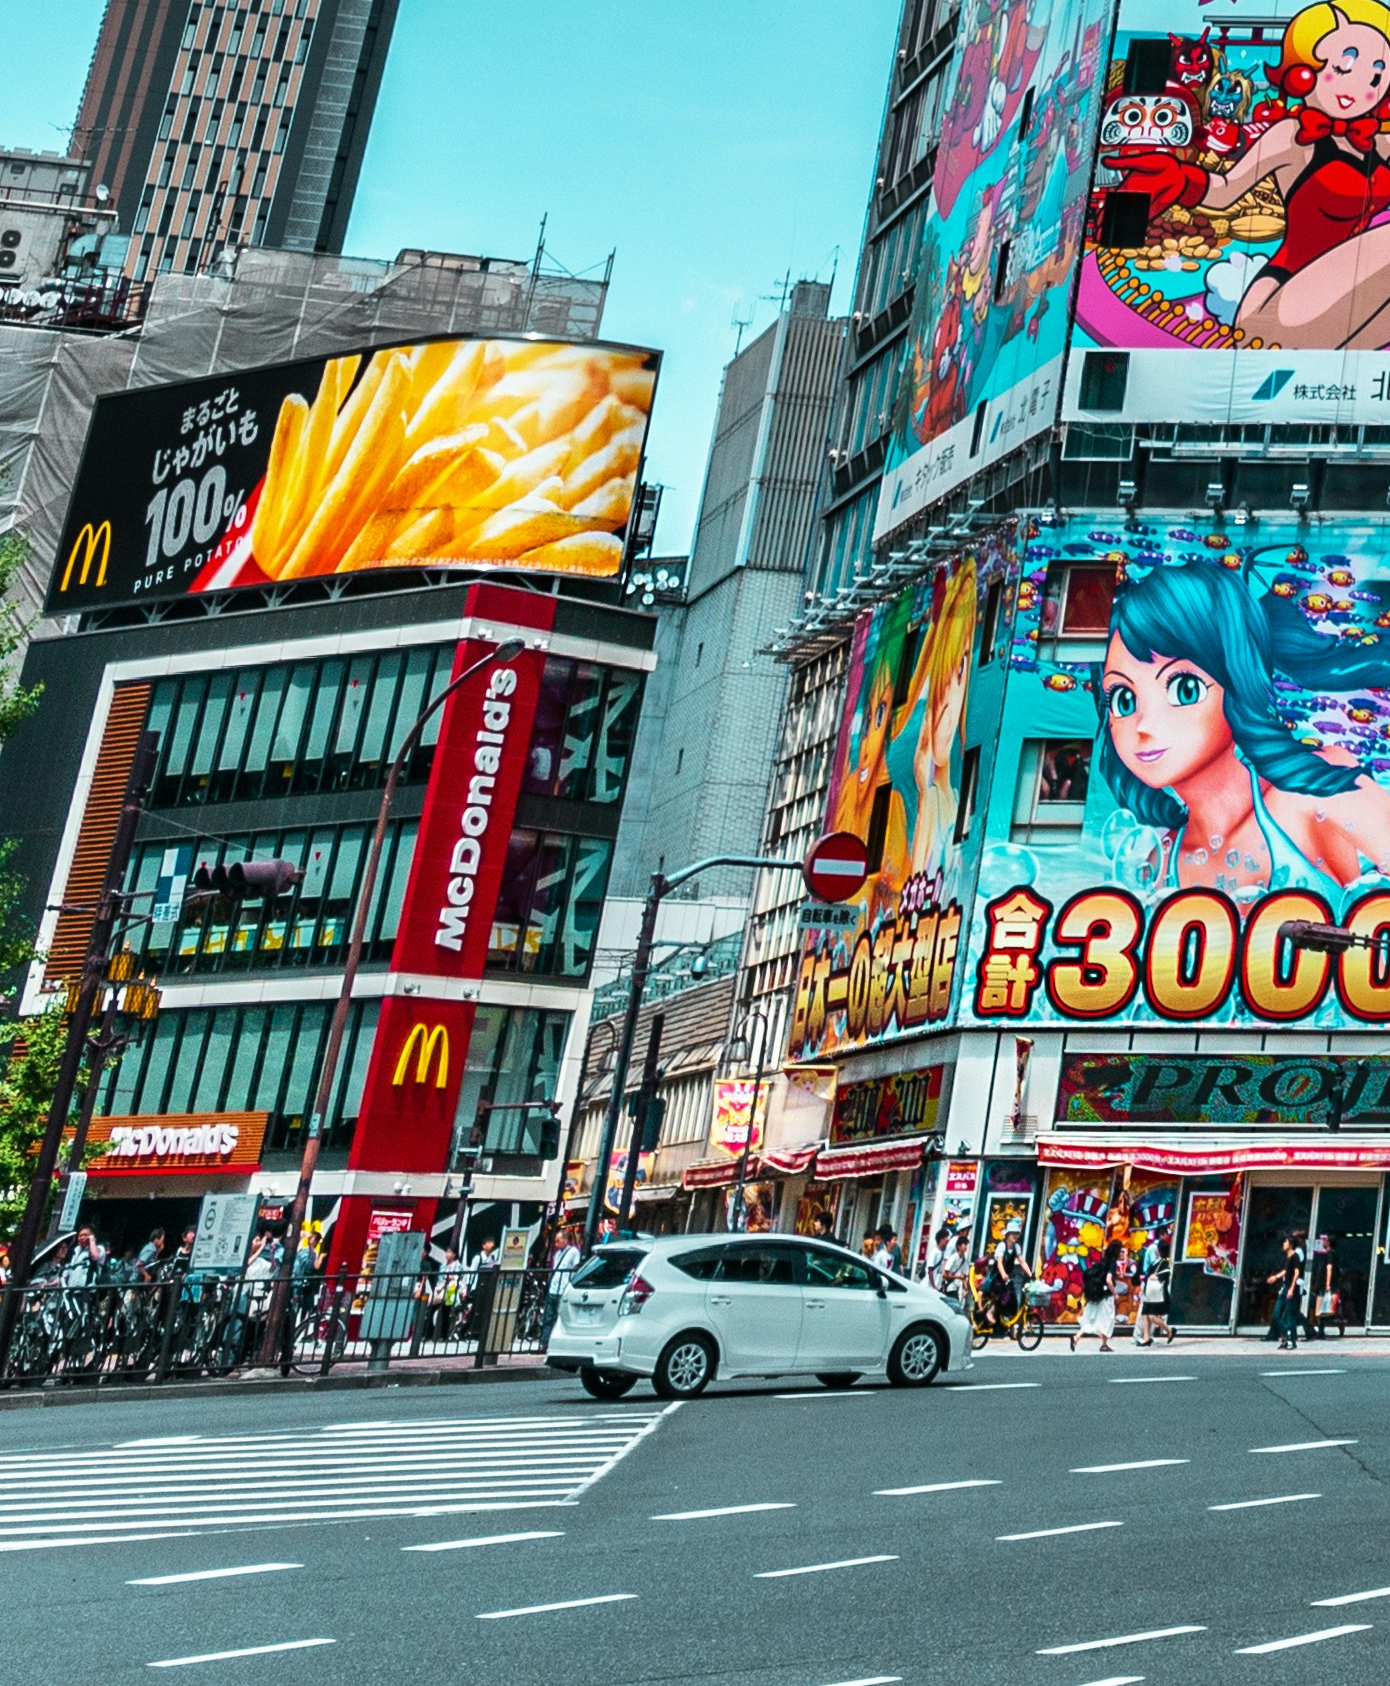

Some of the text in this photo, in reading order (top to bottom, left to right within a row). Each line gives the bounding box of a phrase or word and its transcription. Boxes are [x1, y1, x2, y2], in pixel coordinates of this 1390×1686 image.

[180, 387, 240, 435] まるごと
[1293, 384, 1357, 402] 株式会社
[152, 409, 259, 485] じゃがいも
[145, 465, 247, 567] 100%
[133, 565, 174, 594] PURE
[434, 667, 518, 953] McDonald's
[977, 884, 1053, 1017] 合計
